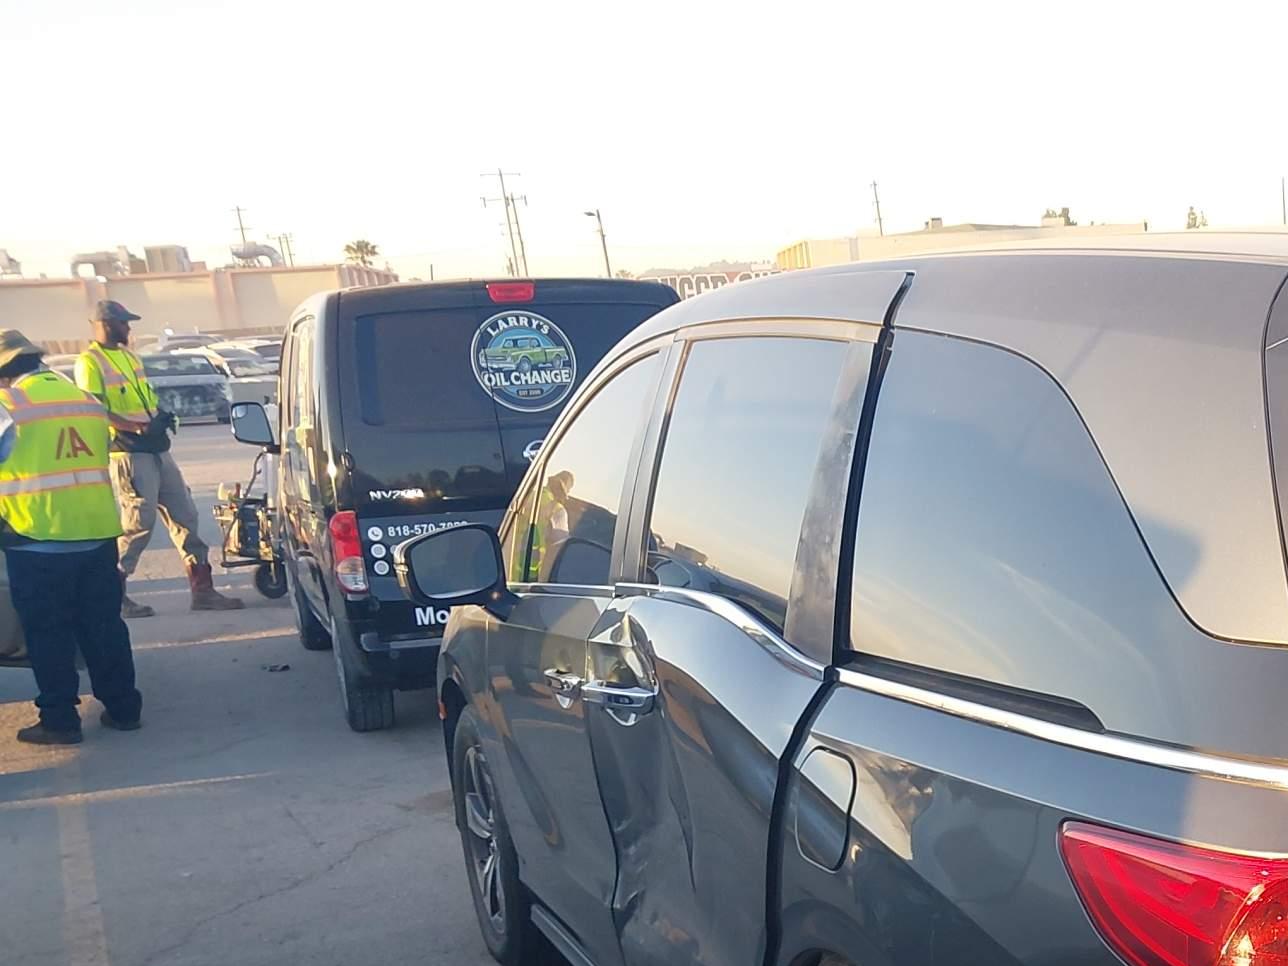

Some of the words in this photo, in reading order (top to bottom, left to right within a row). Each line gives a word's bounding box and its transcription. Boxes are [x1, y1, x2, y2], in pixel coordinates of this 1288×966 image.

[486, 316, 550, 337] LARRY'S
[483, 372, 510, 387] OIL
[510, 369, 571, 386] CHANGE
[387, 520, 468, 537] 818-570-7
